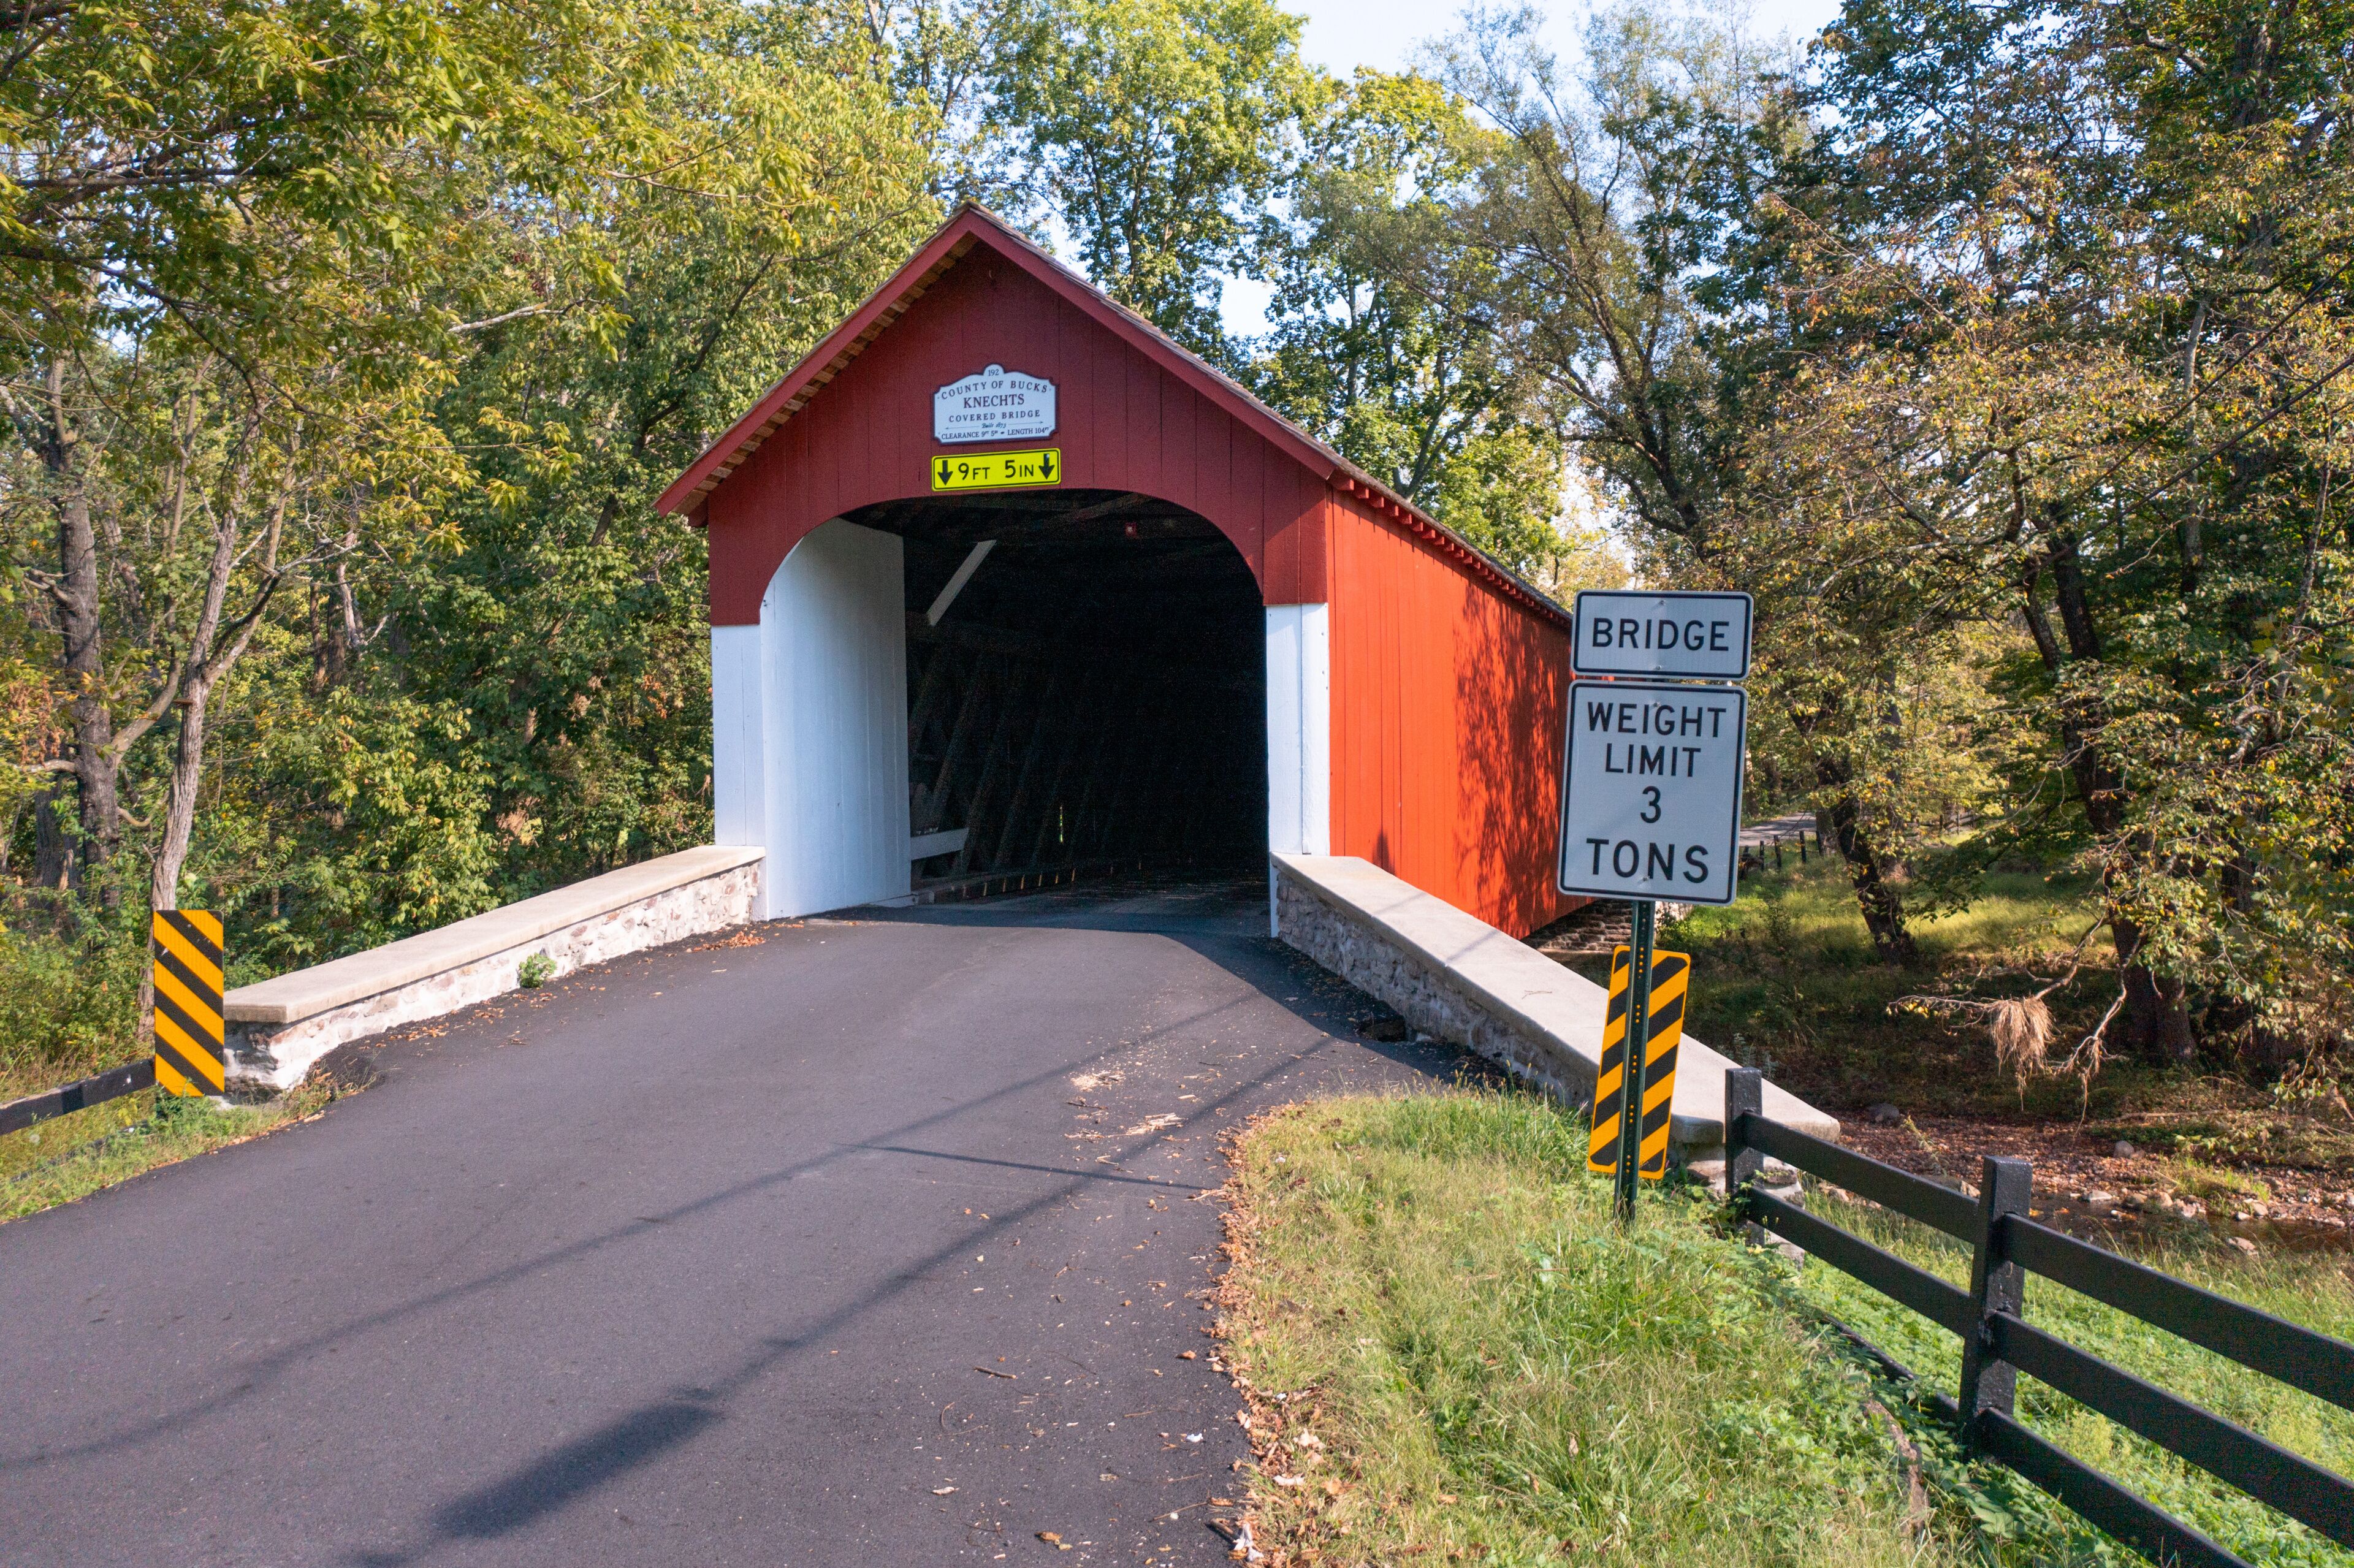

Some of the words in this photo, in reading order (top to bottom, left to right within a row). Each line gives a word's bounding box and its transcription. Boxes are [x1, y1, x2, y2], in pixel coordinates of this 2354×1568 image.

[942, 381, 987, 399] COUNTY
[1010, 381, 1047, 393] BUCKS
[964, 394, 1024, 408] KNECHTS
[949, 413, 996, 422] COVERED
[1002, 409, 1040, 419] BRIDGE
[1593, 617, 1729, 651] BRIDGE
[1588, 701, 1726, 738] WEIGHT
[1605, 742, 1701, 777] LIMIT
[1640, 785, 1661, 823] 3
[1586, 837, 1708, 883] TONS
